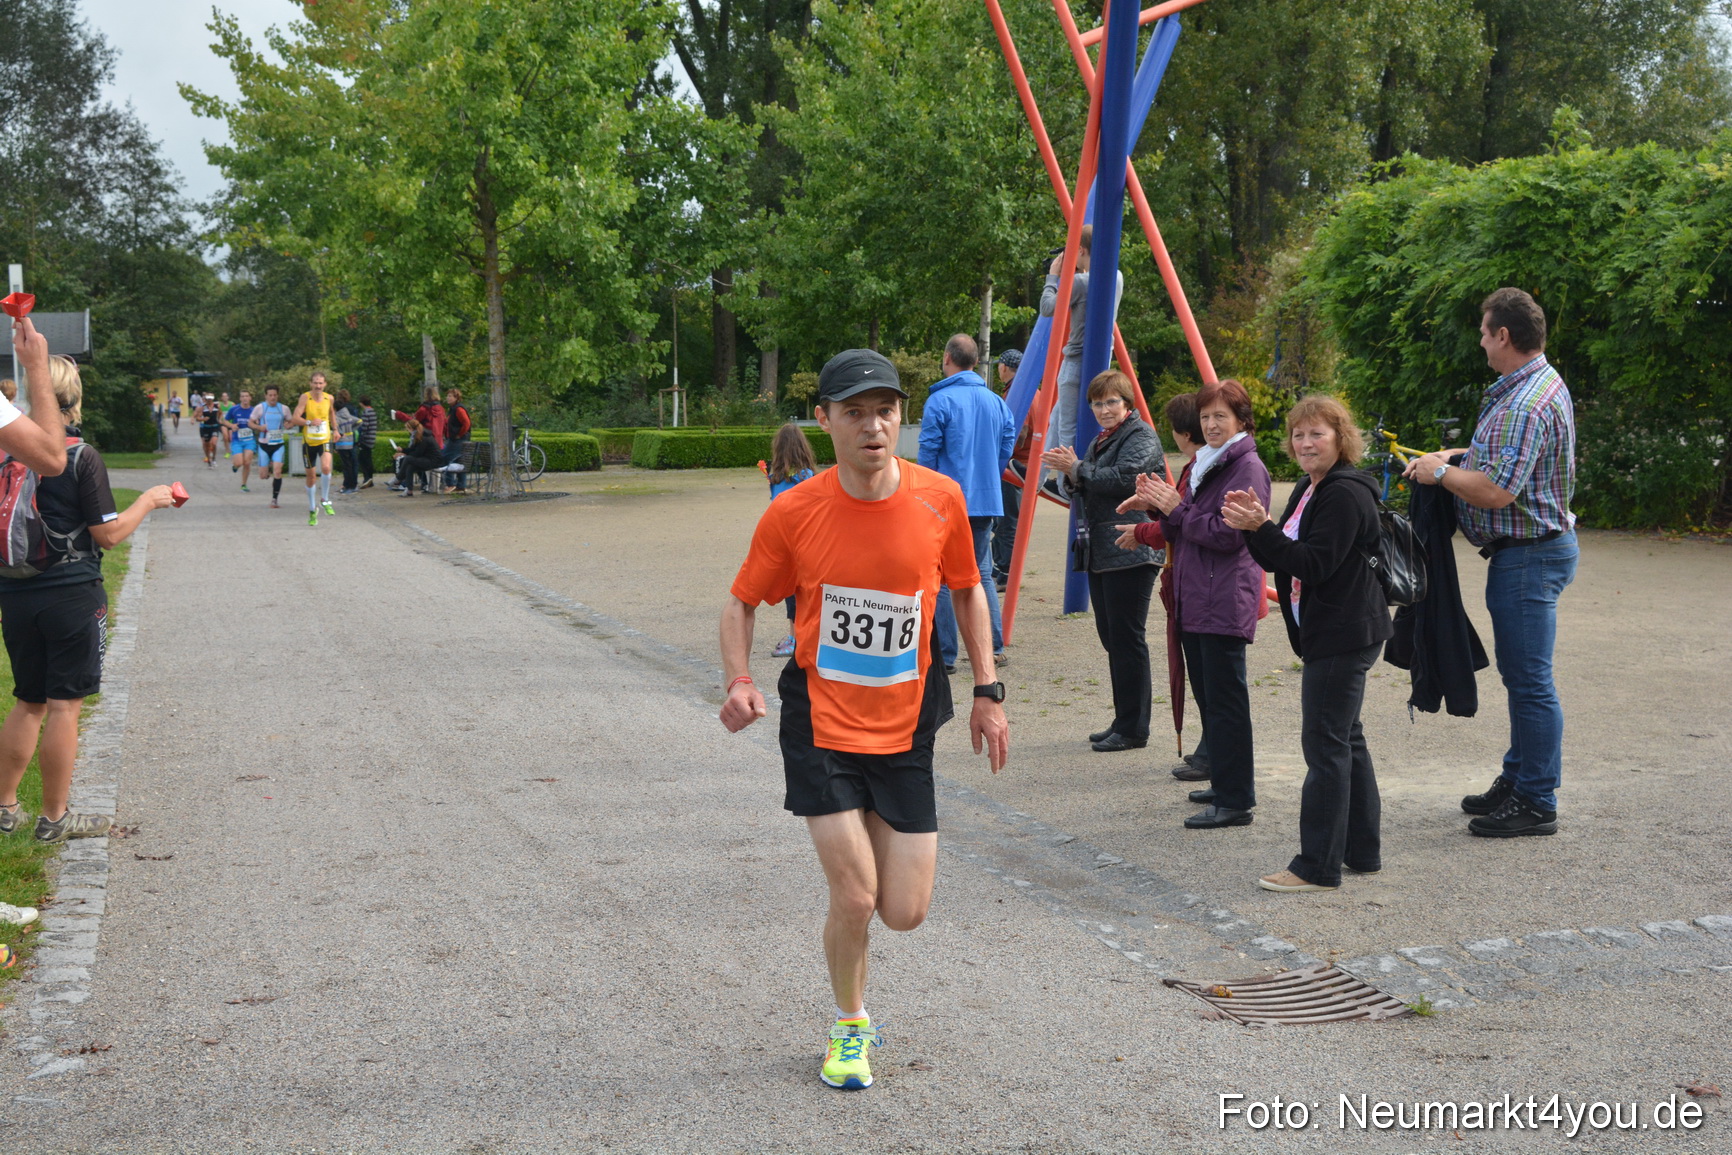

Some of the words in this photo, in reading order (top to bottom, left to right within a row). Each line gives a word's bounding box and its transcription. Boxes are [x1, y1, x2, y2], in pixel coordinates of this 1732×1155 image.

[825, 593, 860, 608] PARTL
[863, 599, 913, 615] Neumarkt
[830, 609, 916, 652] 3318
